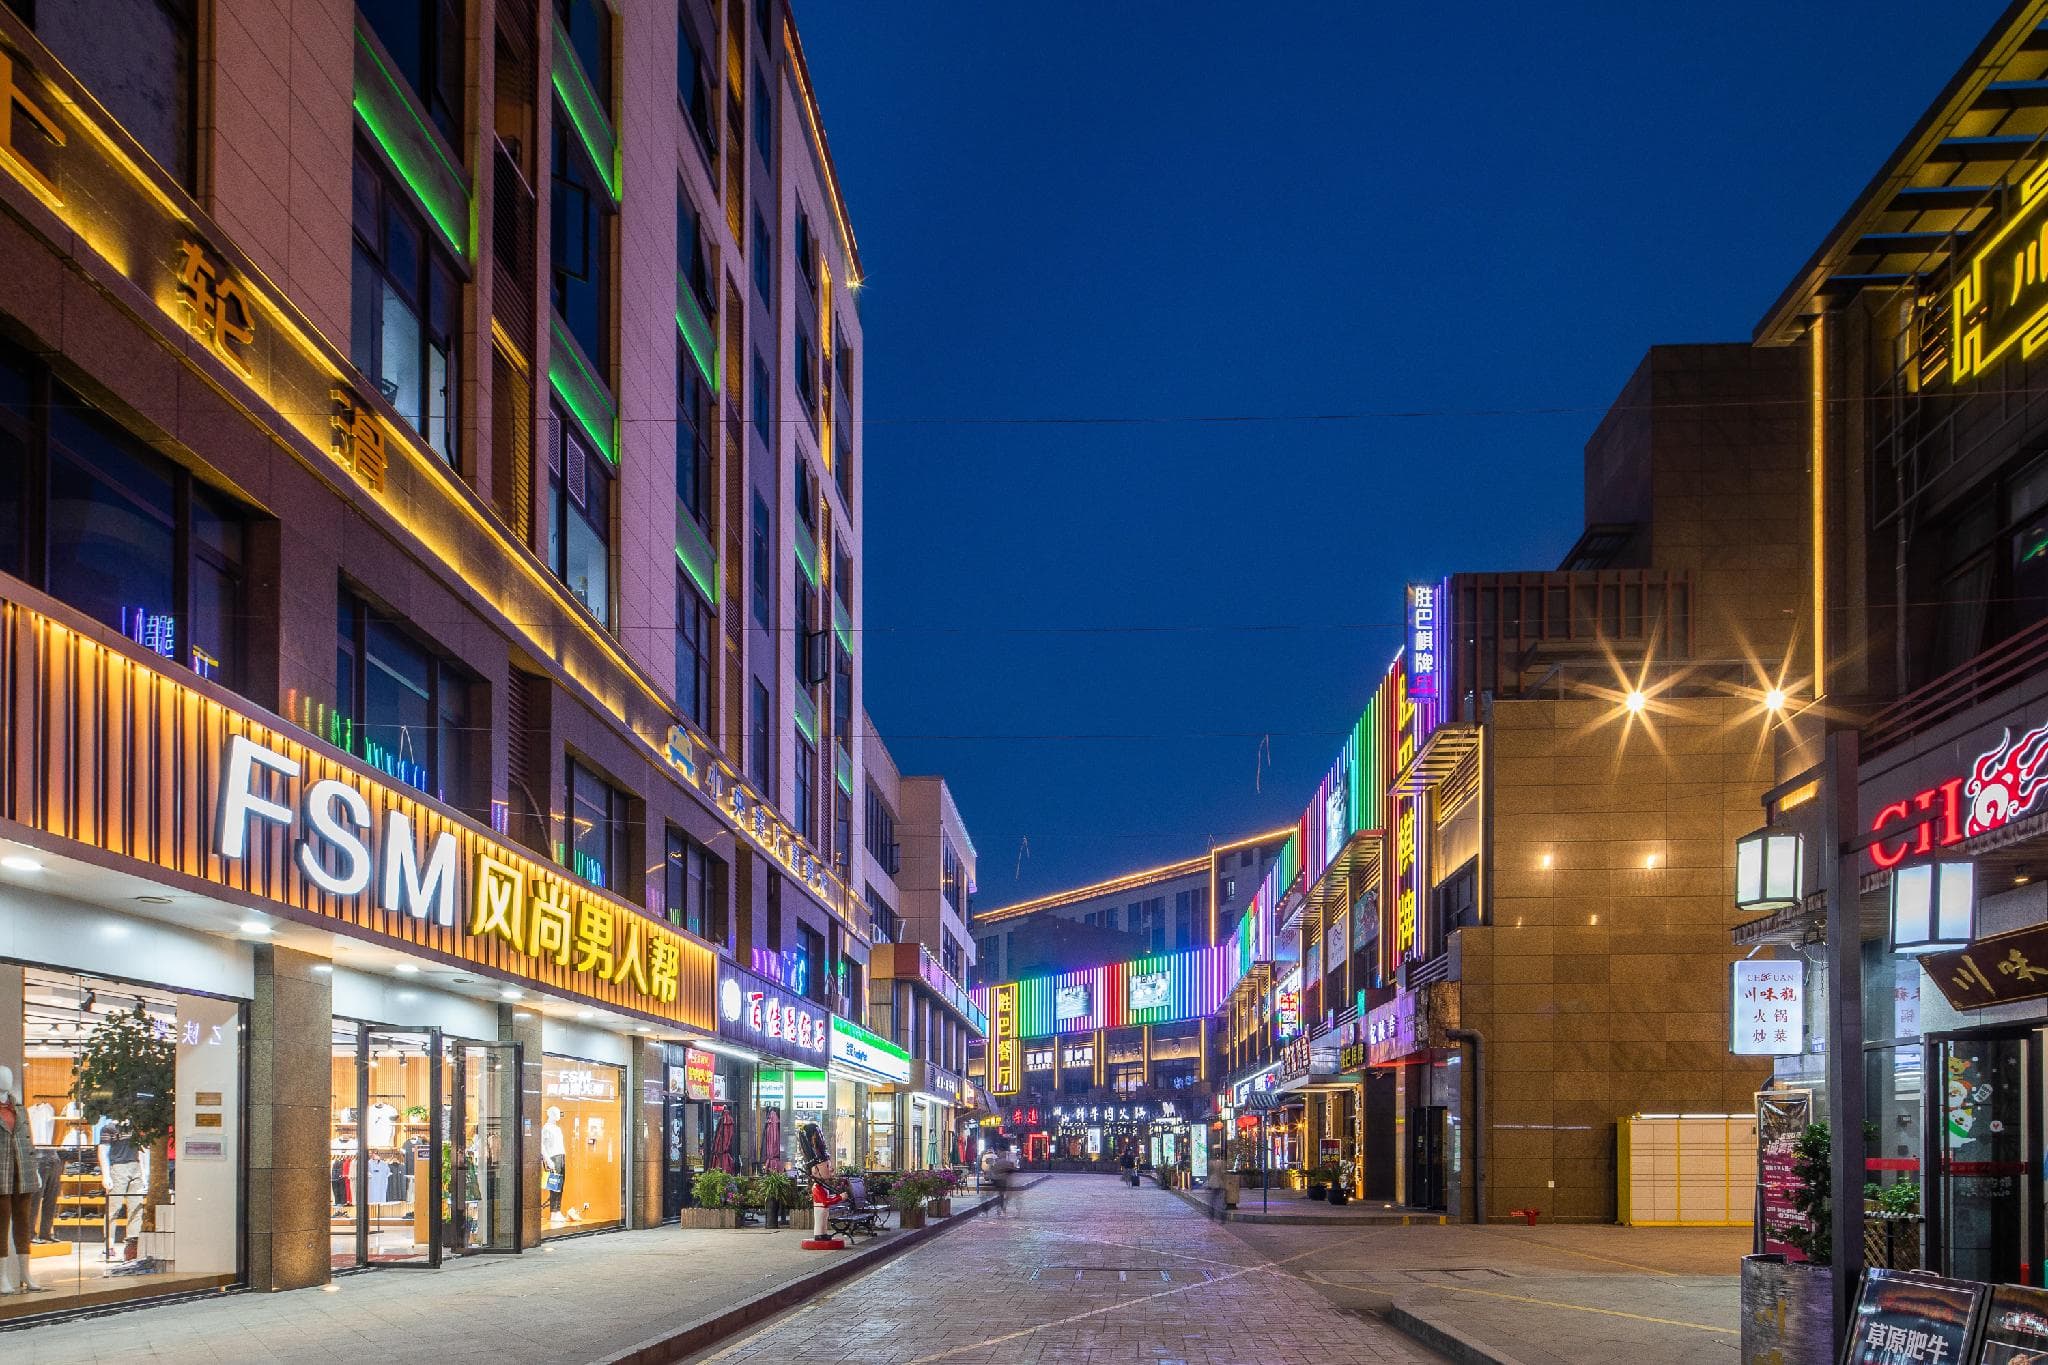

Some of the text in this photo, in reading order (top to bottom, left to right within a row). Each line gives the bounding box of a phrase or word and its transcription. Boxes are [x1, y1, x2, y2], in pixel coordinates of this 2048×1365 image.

[1415, 587, 1433, 673] 胜巴棋牌
[216, 733, 458, 927] FSM
[471, 852, 680, 1003] 风尚男人帮
[999, 992, 1011, 1085] 胜巴餐厅
[1752, 1028, 1788, 1043] 炒菜
[1753, 1008, 1788, 1023] 火锅
[1865, 1321, 1950, 1365] 草原肥牛
